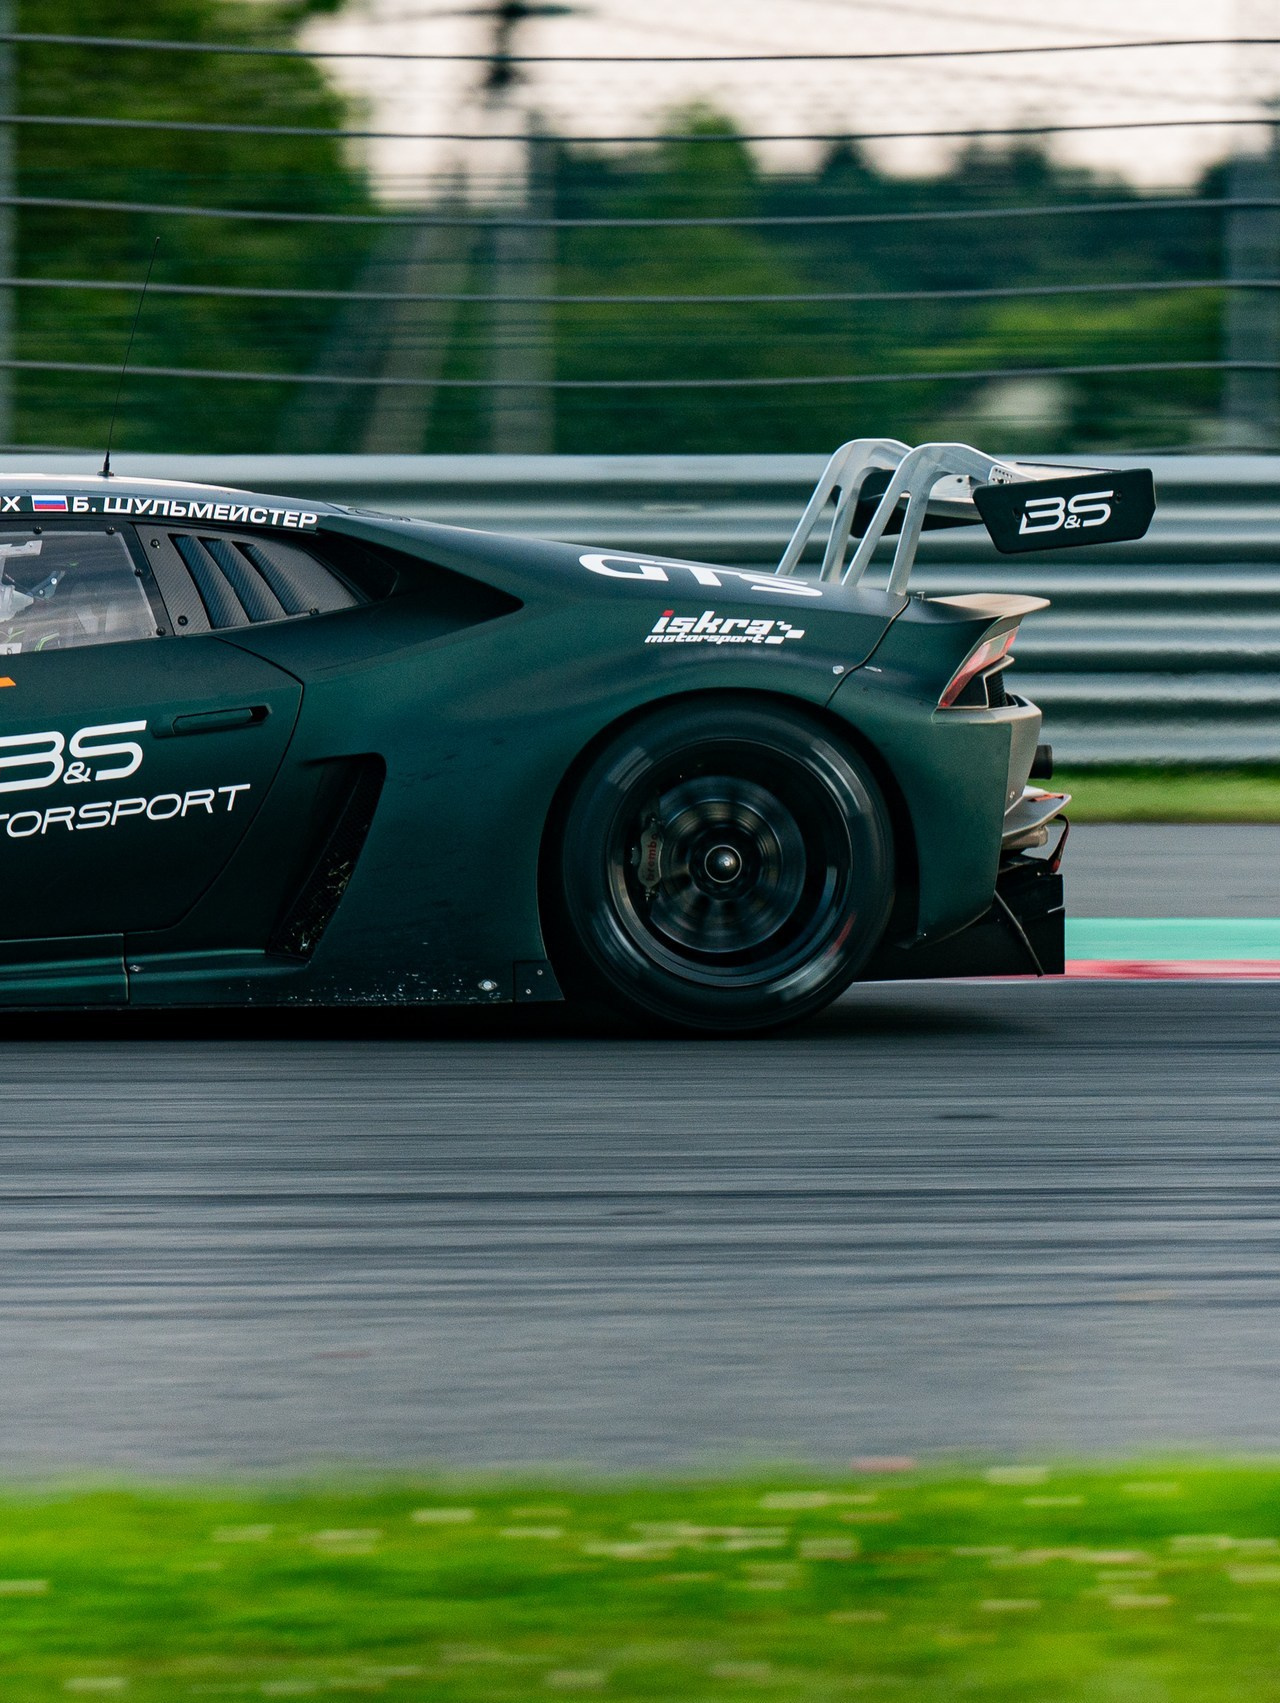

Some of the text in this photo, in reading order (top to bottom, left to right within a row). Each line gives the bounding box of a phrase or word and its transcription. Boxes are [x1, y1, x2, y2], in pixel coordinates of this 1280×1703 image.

[72, 496, 97, 513] Б.
[1018, 490, 1114, 535] B&S
[651, 610, 775, 635] iskra
[644, 632, 767, 645] motorsport
